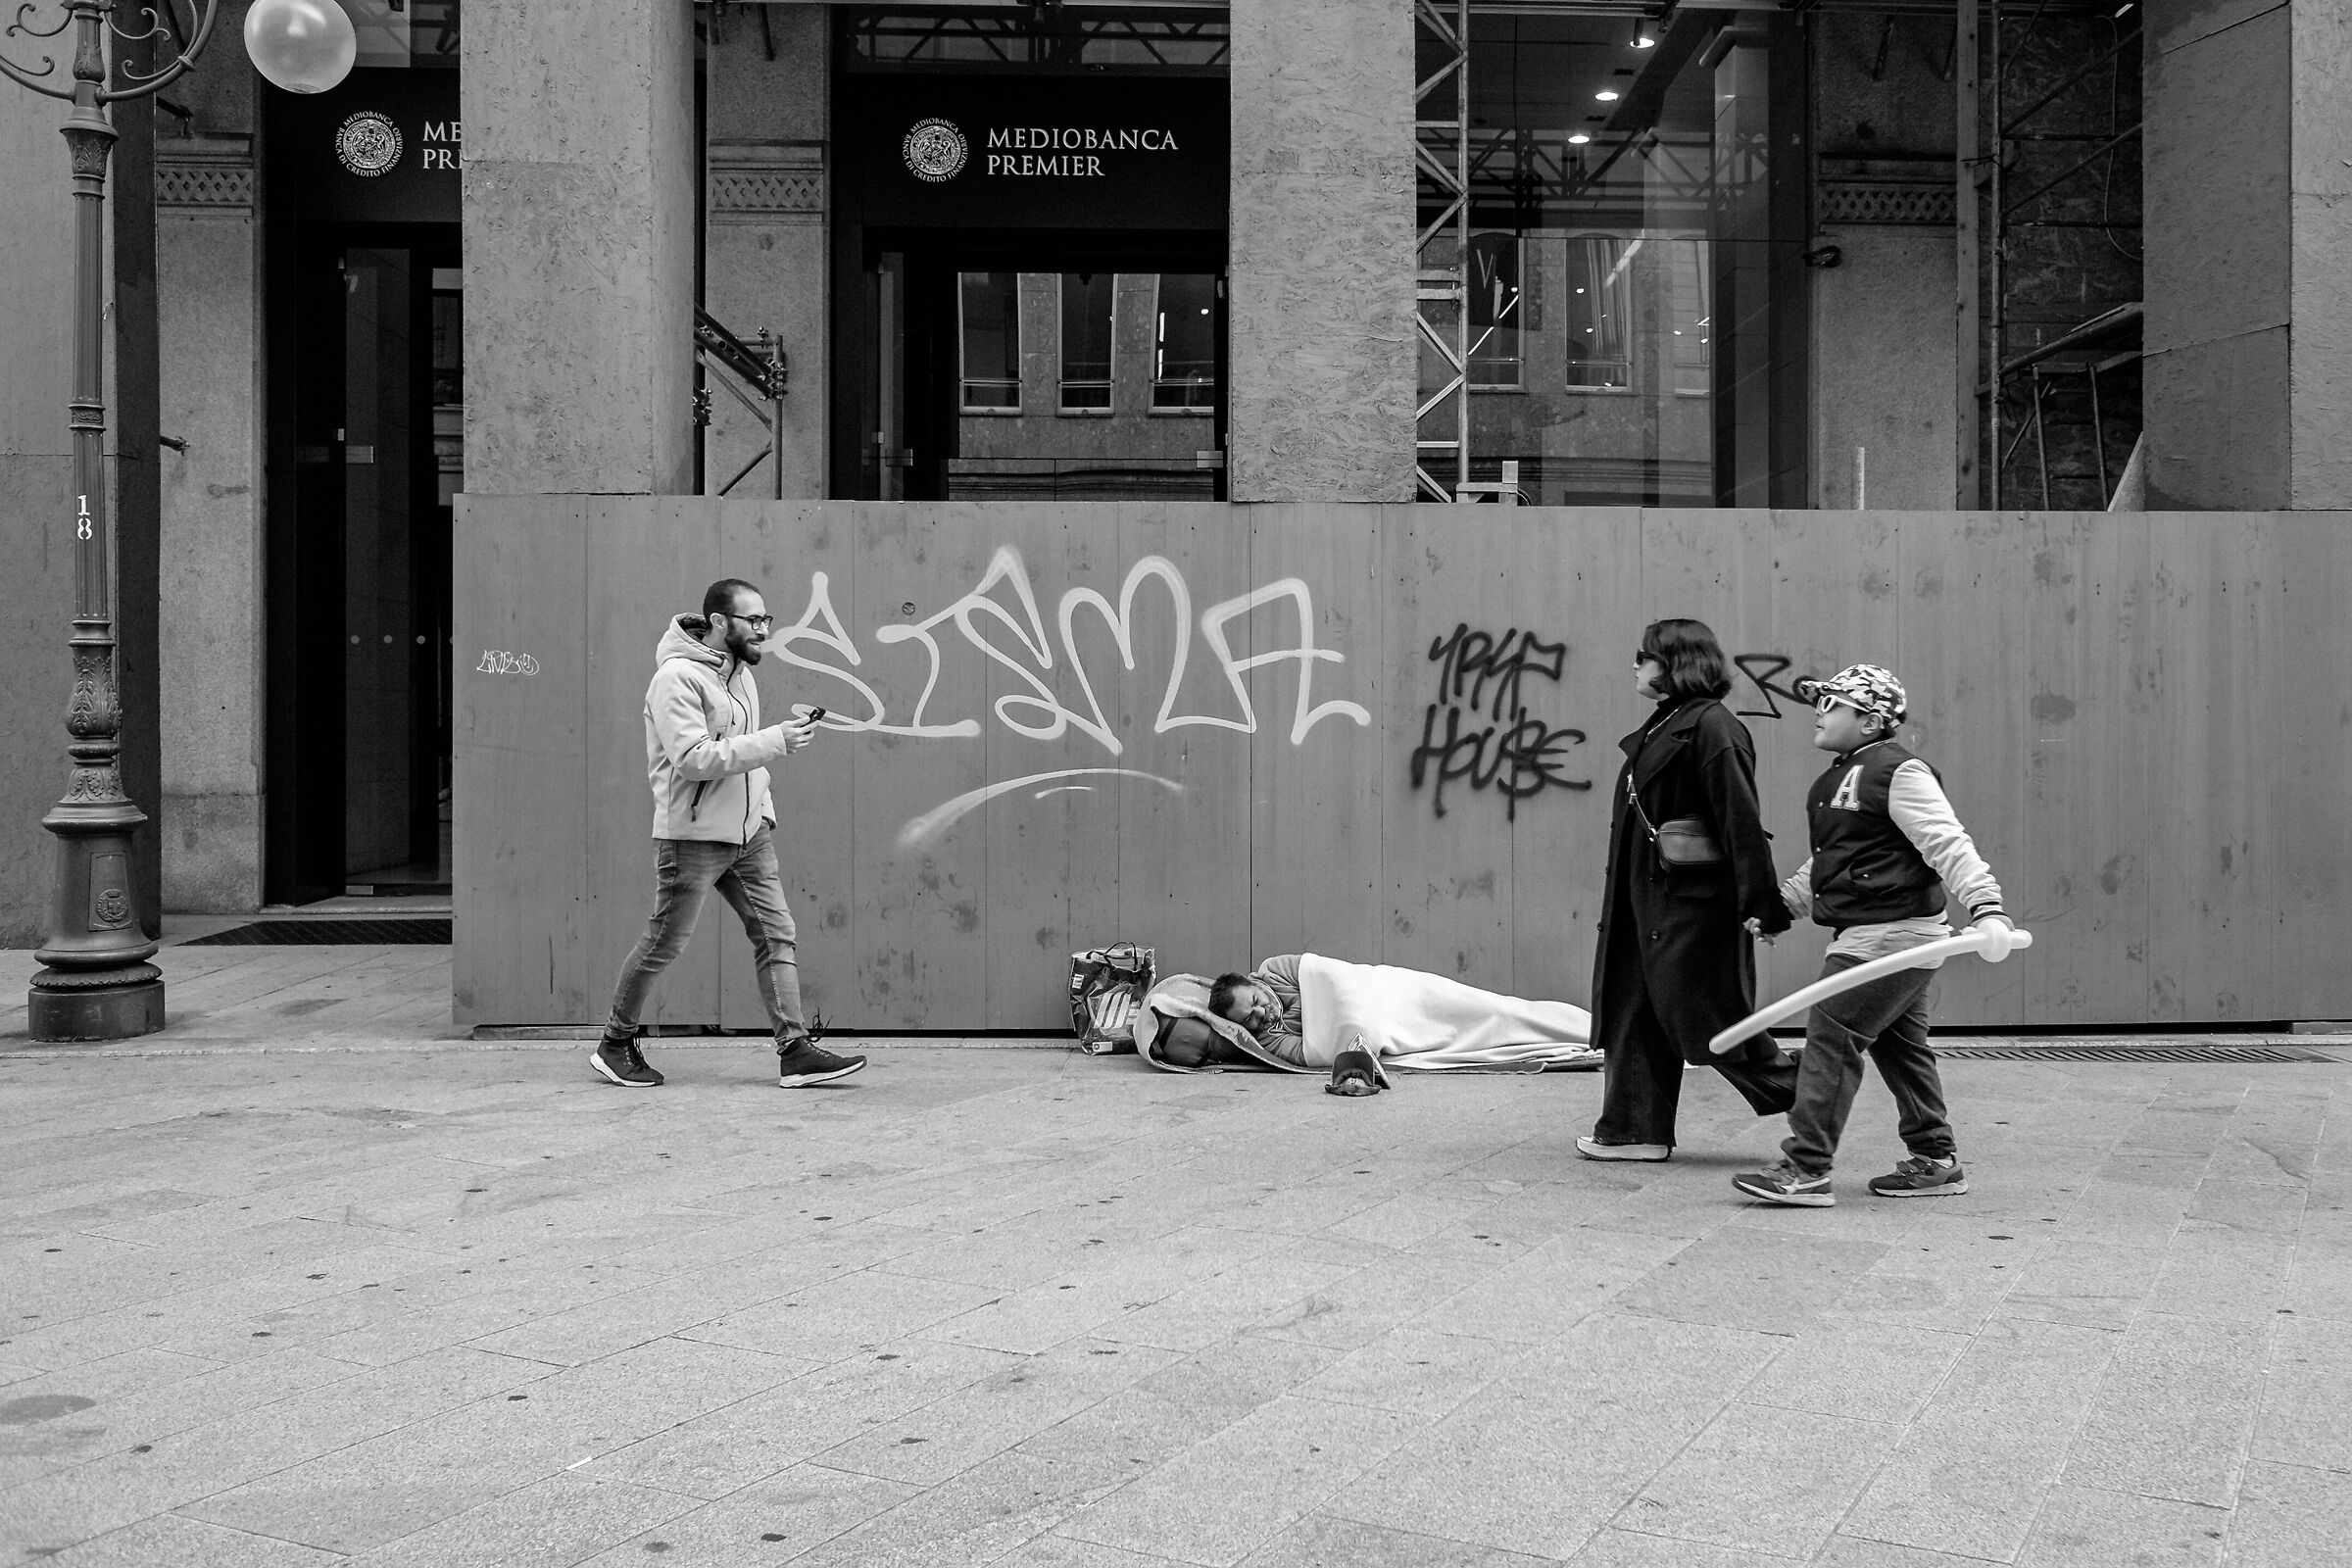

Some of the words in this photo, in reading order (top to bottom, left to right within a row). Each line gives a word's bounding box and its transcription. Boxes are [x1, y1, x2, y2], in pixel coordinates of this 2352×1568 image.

[343, 111, 394, 127] MEDIOBANCA
[909, 118, 959, 134] MEDIOBANCA
[335, 126, 346, 154] BANCA
[381, 126, 404, 173] FINANZIARIO
[902, 133, 912, 160] BANCA
[987, 127, 1179, 150] MEDIOBANCA
[338, 155, 348, 165] DI
[422, 148, 463, 170] PR
[906, 160, 915, 171] DI
[947, 133, 968, 179] FINANZIARIO
[987, 154, 1105, 176] PREMIER
[346, 163, 381, 177] CREDITO
[912, 169, 947, 183] CREDITO
[1830, 763, 1864, 812] A
